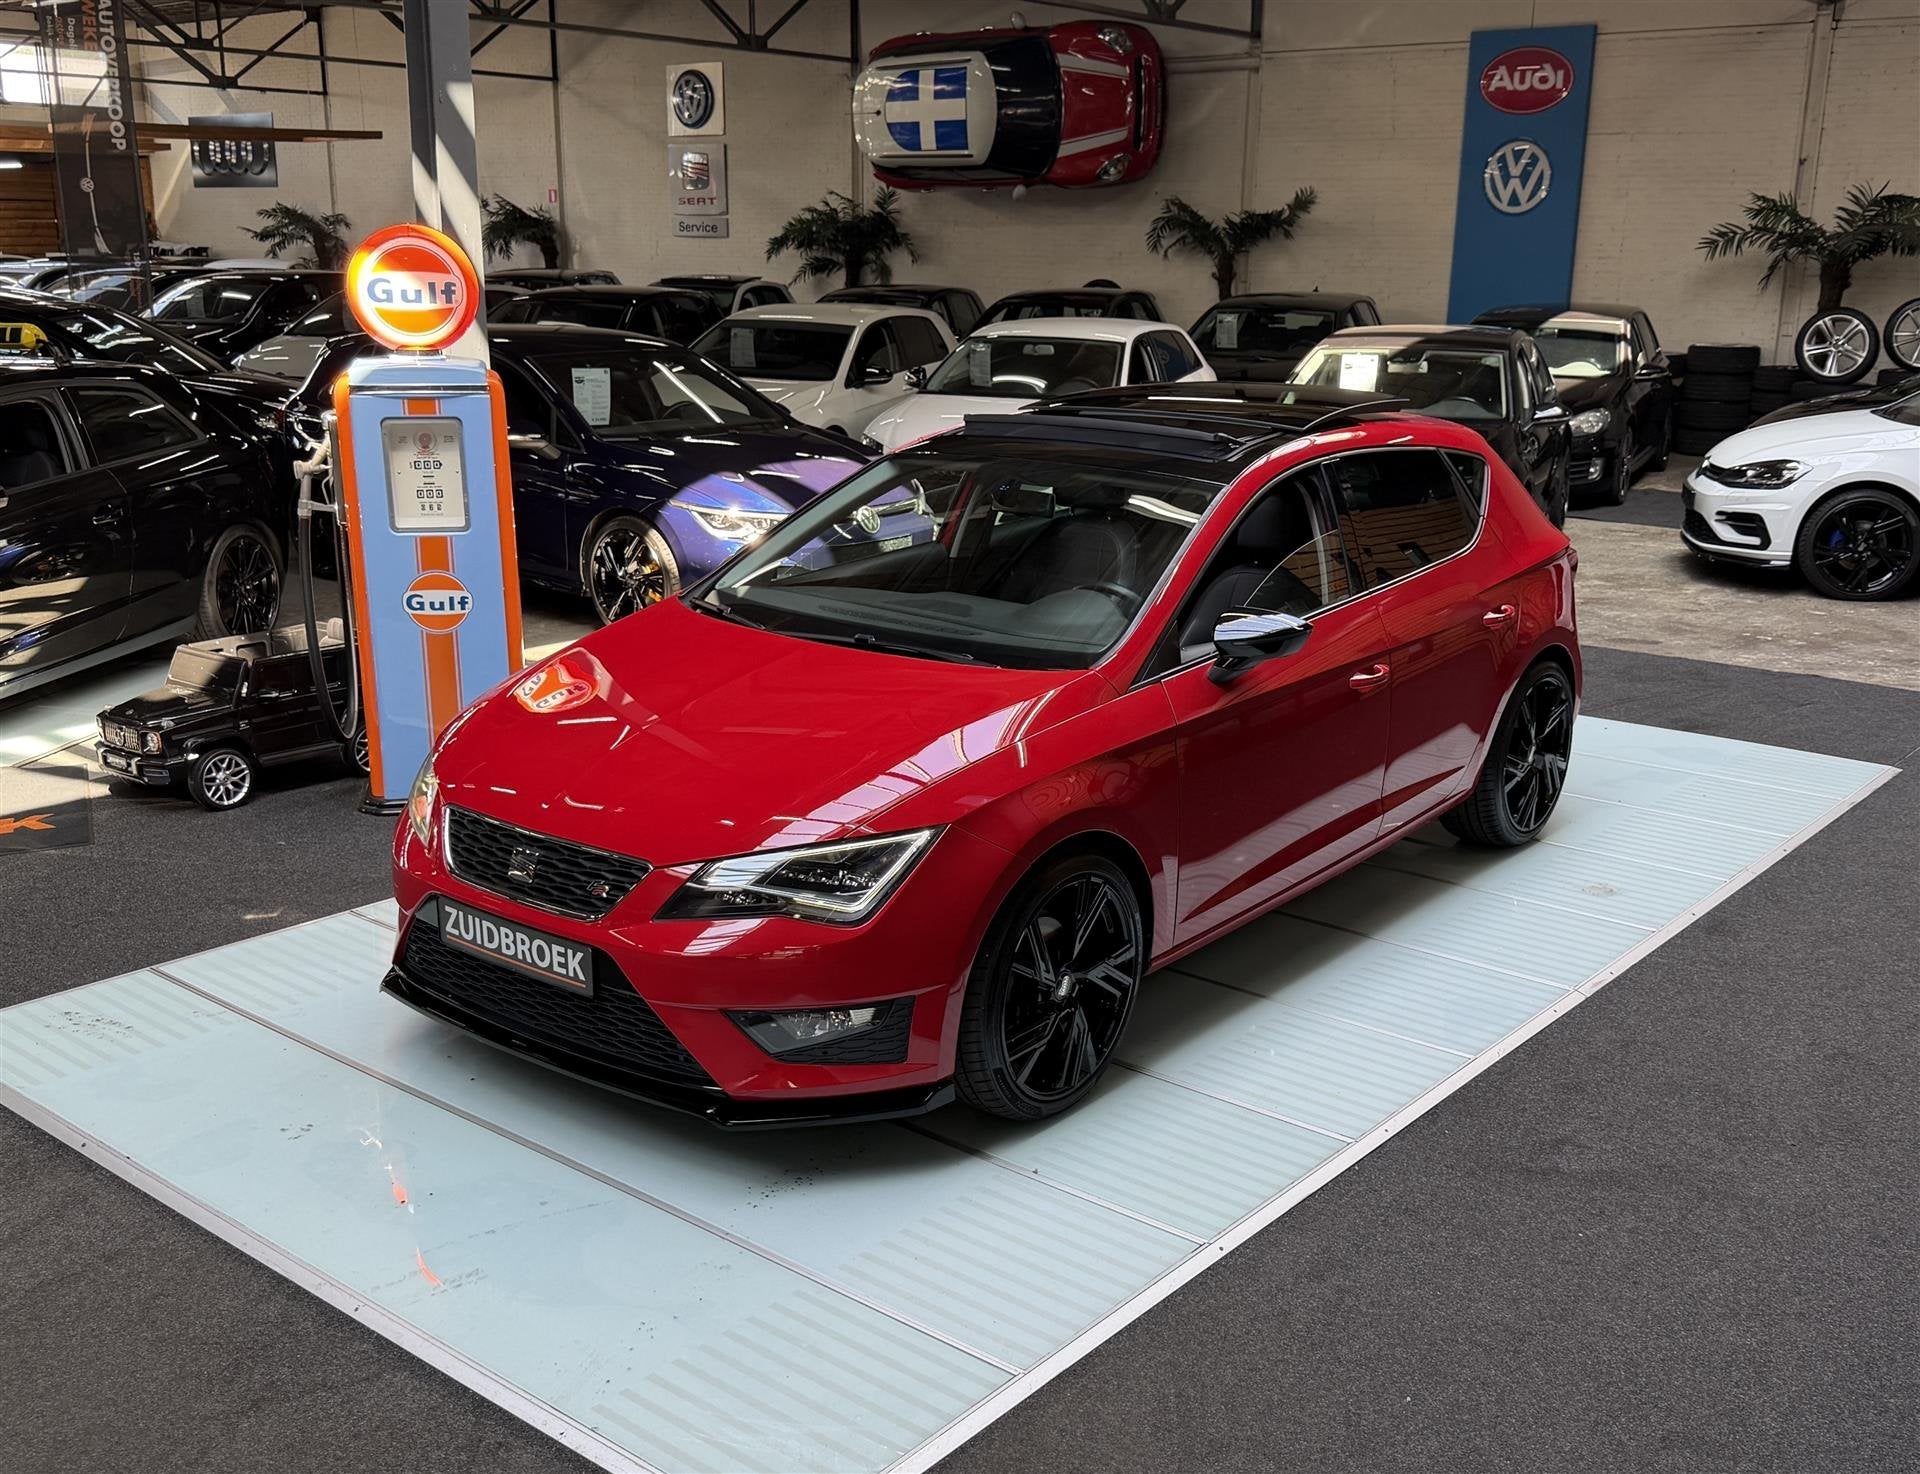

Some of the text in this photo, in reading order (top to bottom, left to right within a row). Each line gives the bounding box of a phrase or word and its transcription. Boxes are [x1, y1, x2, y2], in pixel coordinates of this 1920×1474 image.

[678, 197, 717, 206] SEAT
[678, 221, 718, 234] Service
[367, 278, 457, 305] Gulf
[405, 594, 470, 612] Gulf
[443, 904, 587, 982] ZUIDBROEK
